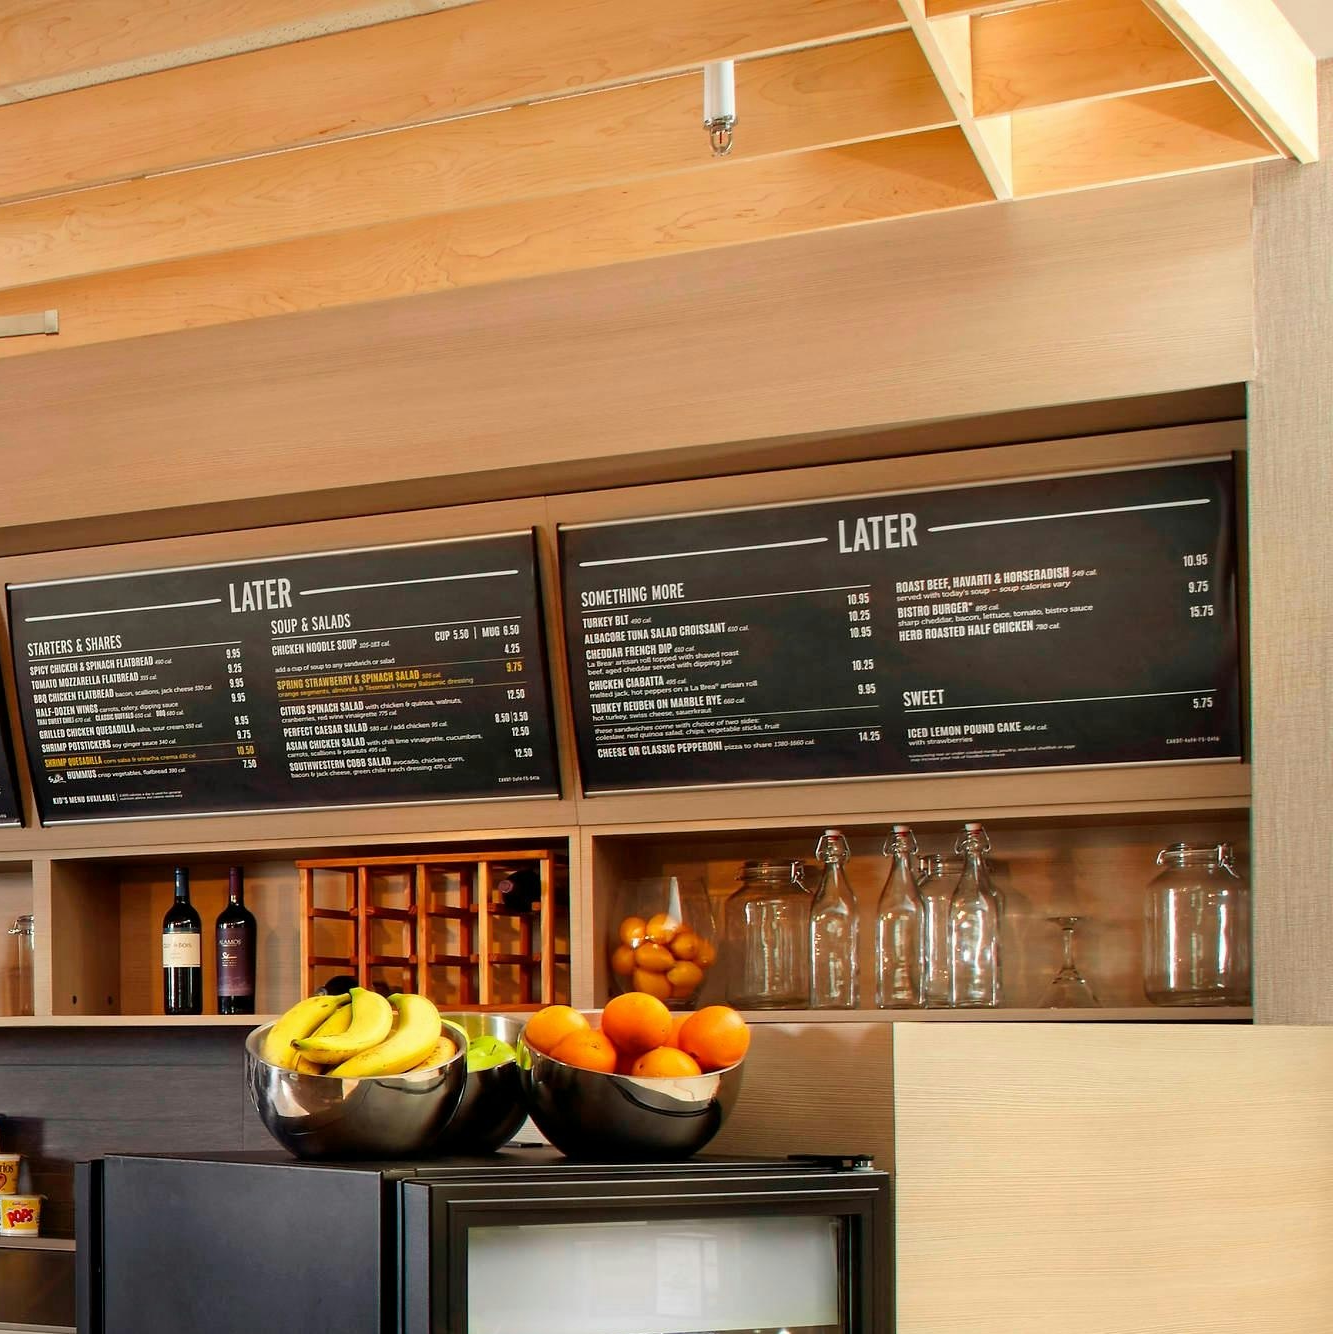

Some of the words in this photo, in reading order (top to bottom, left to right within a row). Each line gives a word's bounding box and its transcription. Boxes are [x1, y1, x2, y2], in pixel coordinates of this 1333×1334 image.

[839, 512, 917, 554] LATER
[1183, 554, 1207, 567] 10.95
[896, 580, 925, 593] ROAST
[927, 578, 951, 591] BEEF,
[953, 574, 991, 588] HAVARTI
[994, 573, 1001, 584] &
[1004, 567, 1069, 583] HORSERADISH
[1053, 581, 1071, 589] vary
[1189, 580, 1208, 594] 9.75
[229, 577, 292, 613] LATER
[581, 586, 647, 607] SOMETHING
[652, 582, 684, 601] MORE
[847, 593, 869, 605] 10.95
[849, 610, 870, 621] 10.25
[898, 606, 929, 618] BISTRO
[1190, 604, 1213, 618] 15.75
[271, 619, 297, 634] SOUP
[301, 618, 308, 632] &
[312, 614, 351, 631] SALADS
[583, 617, 613, 629] TURKEY
[615, 615, 629, 626] BLT
[435, 630, 450, 641] CUP
[453, 629, 469, 640] 5.50
[482, 626, 500, 637] MUG
[503, 624, 519, 635] 6.50
[584, 632, 625, 644] ALBACORE
[627, 630, 648, 641] TUNA
[651, 627, 677, 639] SALAD
[679, 622, 725, 636] CROISSANT
[899, 629, 922, 641] HERB
[925, 626, 965, 640] ROASTED
[968, 624, 991, 636] HALF
[993, 620, 1033, 634] CHICKEN
[28, 640, 72, 656] STARTERS
[76, 639, 82, 651] &
[85, 635, 122, 650] SHARES
[272, 644, 304, 656] CHICKEN
[306, 641, 335, 653] NOODLE
[337, 639, 357, 651] SOUP
[505, 643, 520, 653] 4.25
[226, 649, 240, 659] 9.95
[30, 666, 48, 676] SPICY
[50, 663, 78, 674] CHICKEN
[80, 663, 84, 672] &
[86, 660, 114, 671] SPINACH
[116, 657, 153, 669] FLATBREAD
[228, 663, 242, 673] 9.25
[506, 662, 522, 672] 9.75
[32, 679, 57, 690] TOMATO
[59, 676, 100, 688] MOZZARELLA
[102, 672, 138, 684] FLATBREAD
[277, 678, 303, 690] SPRING
[305, 675, 353, 688] STRAWBERRY
[354, 674, 360, 684] &
[361, 672, 393, 683] SPINACH
[395, 670, 419, 681] SALAD
[903, 689, 944, 707] SWEET
[1193, 697, 1213, 710] 5.75
[908, 727, 928, 739] ICED
[930, 725, 961, 738] LEMON
[964, 723, 994, 736] POUND
[997, 721, 1021, 734] CAKE
[927, 737, 973, 745] strawberries
